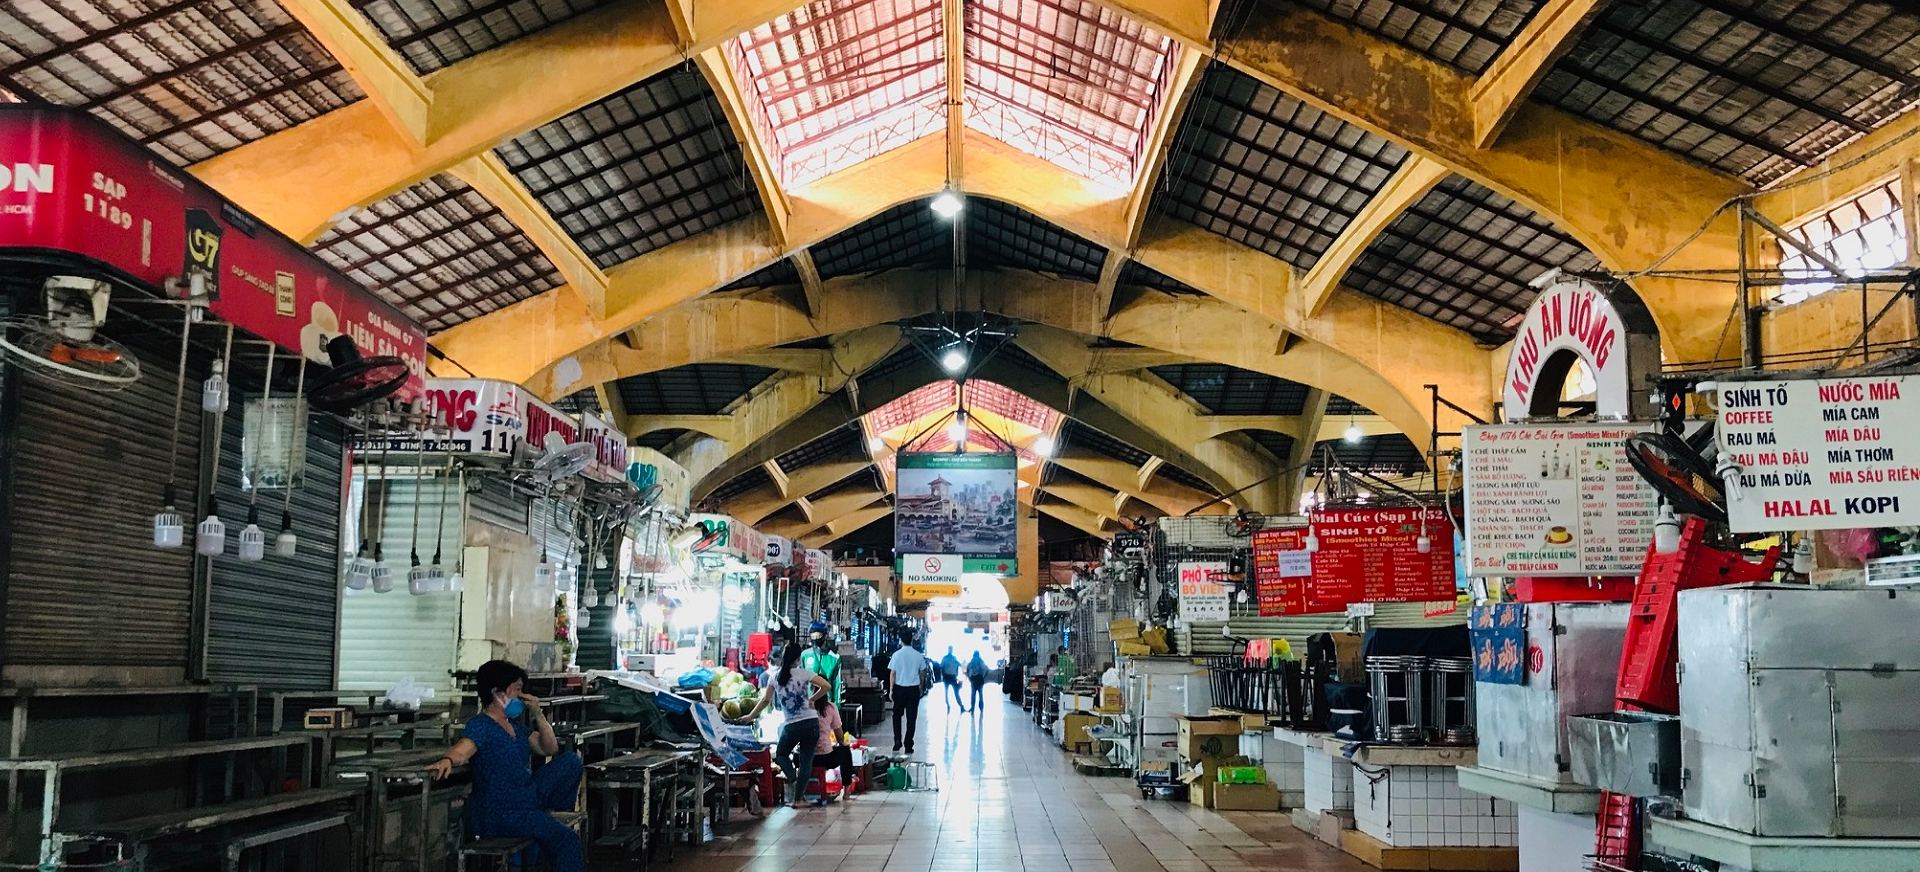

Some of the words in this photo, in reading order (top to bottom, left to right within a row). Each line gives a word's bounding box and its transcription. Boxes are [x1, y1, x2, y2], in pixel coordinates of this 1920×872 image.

[93, 171, 127, 200] SẠP
[84, 193, 132, 230] 1189
[1512, 327, 1539, 405] KHU
[1540, 292, 1562, 347] ĂN
[1569, 291, 1615, 372] UỐNG
[1724, 388, 1762, 408] SINH
[1766, 382, 1788, 406] TỐ
[1818, 378, 1864, 403] NƯỚC
[1869, 377, 1900, 401] MÍA
[1725, 411, 1773, 425] COFFEE
[1823, 404, 1847, 421] MÍA
[1850, 406, 1880, 420] CAM
[1602, 430, 1618, 439] Mixed
[1727, 432, 1753, 446] RAU
[1757, 428, 1777, 444] MÁ
[1825, 425, 1849, 442] MÍA
[1853, 424, 1880, 441] DÂU
[1758, 448, 1778, 466] MÁ
[1827, 446, 1852, 463] MÍA
[1855, 446, 1894, 462] THƠM
[1740, 475, 1756, 488] AU
[1761, 470, 1780, 487] MÁ
[1829, 467, 1854, 485] MÍA
[1888, 465, 1920, 481] RIÊN
[1764, 499, 1837, 518] HALAL
[1844, 496, 1900, 515] KOPI
[1312, 513, 1339, 523] Mai
[1343, 511, 1370, 523] Cúc
[1374, 511, 1406, 524] (Sạp
[1320, 528, 1359, 536] SINH
[1364, 524, 1388, 535] TỐ
[1121, 538, 1139, 547] 976
[1326, 536, 1378, 544] (Smoothies
[1560, 550, 1577, 559] RIÊNG
[980, 563, 996, 571] EXIT
[1548, 562, 1558, 570] SEN
[921, 575, 957, 583] SMOKING
